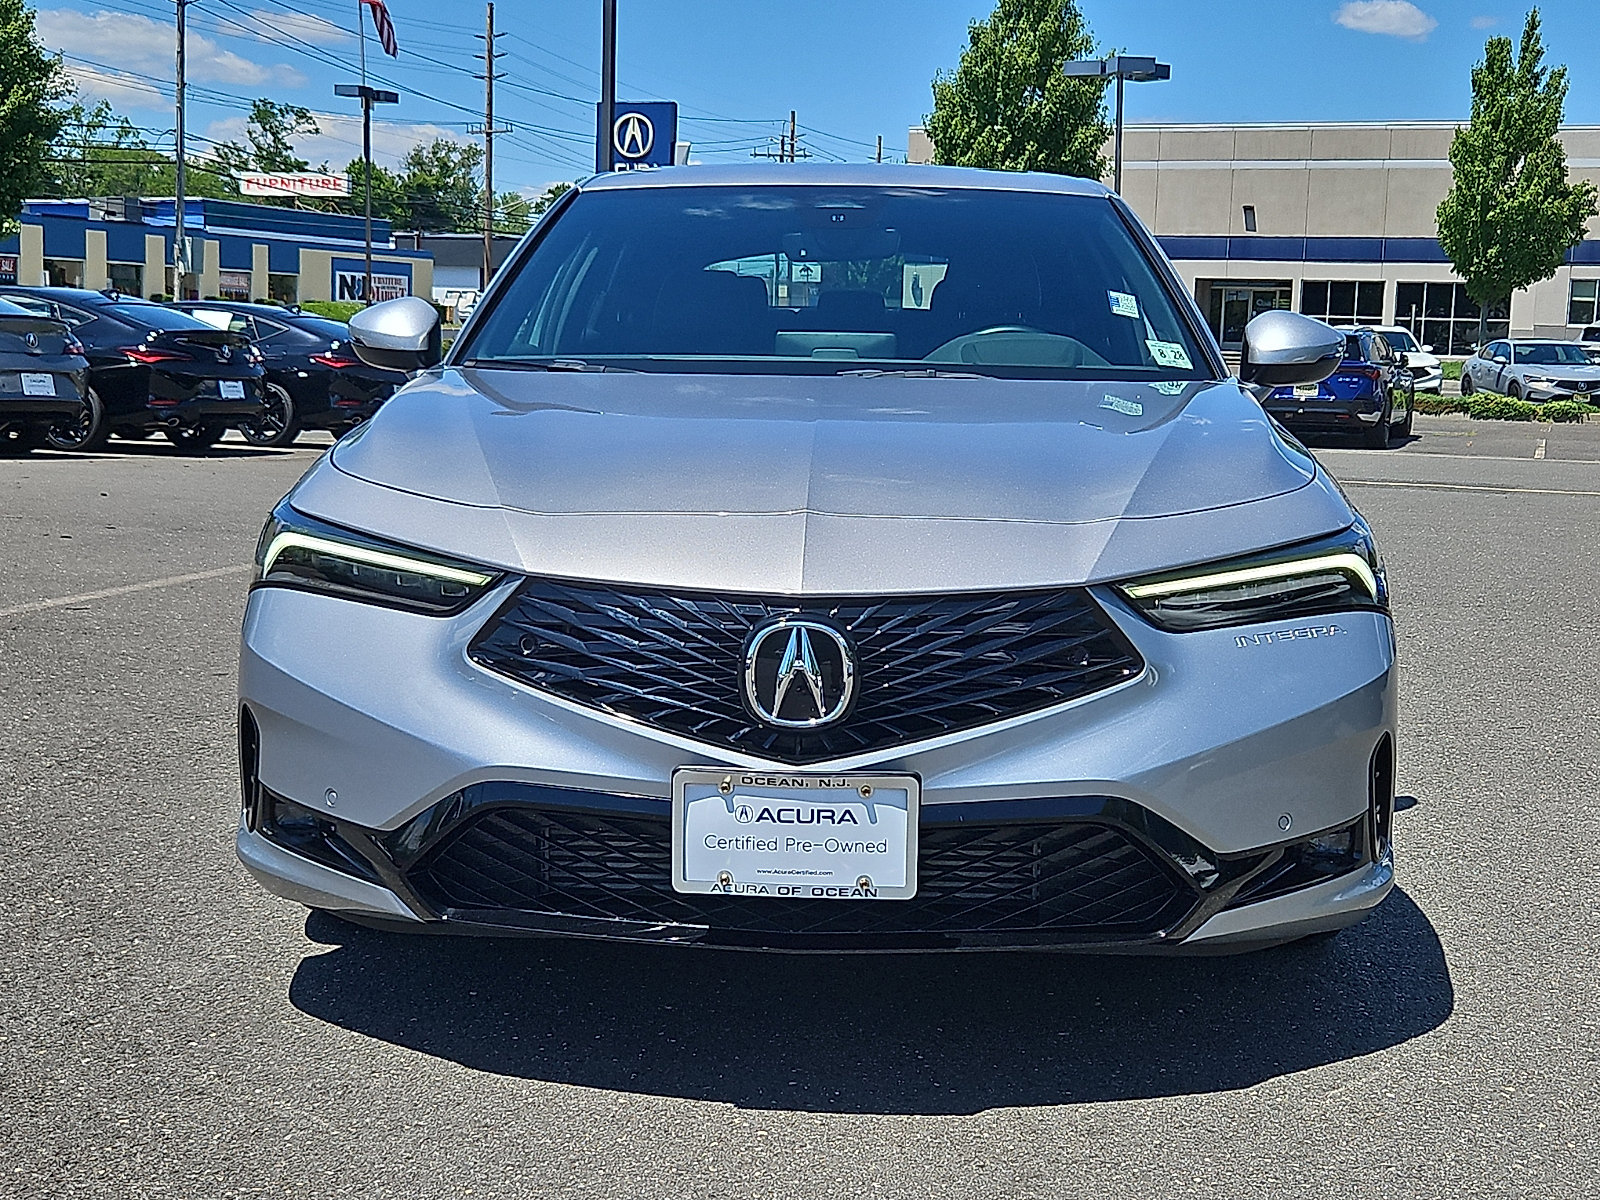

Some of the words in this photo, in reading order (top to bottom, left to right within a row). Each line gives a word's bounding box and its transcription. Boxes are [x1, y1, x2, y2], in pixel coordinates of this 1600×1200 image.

[245, 177, 342, 191] FURNITURE
[1157, 348, 1167, 358] 8
[1234, 624, 1347, 648] INTEGRA
[741, 776, 809, 788] OCEAN,
[818, 778, 850, 787] N.J.
[755, 807, 859, 825] ACURA
[704, 834, 778, 851] Certified
[785, 837, 888, 855] Pre-Owned
[756, 869, 834, 877] www.AcuraCertified.com
[710, 883, 770, 895] ACURA
[777, 886, 802, 896] OF
[811, 886, 878, 898] OCEAN
